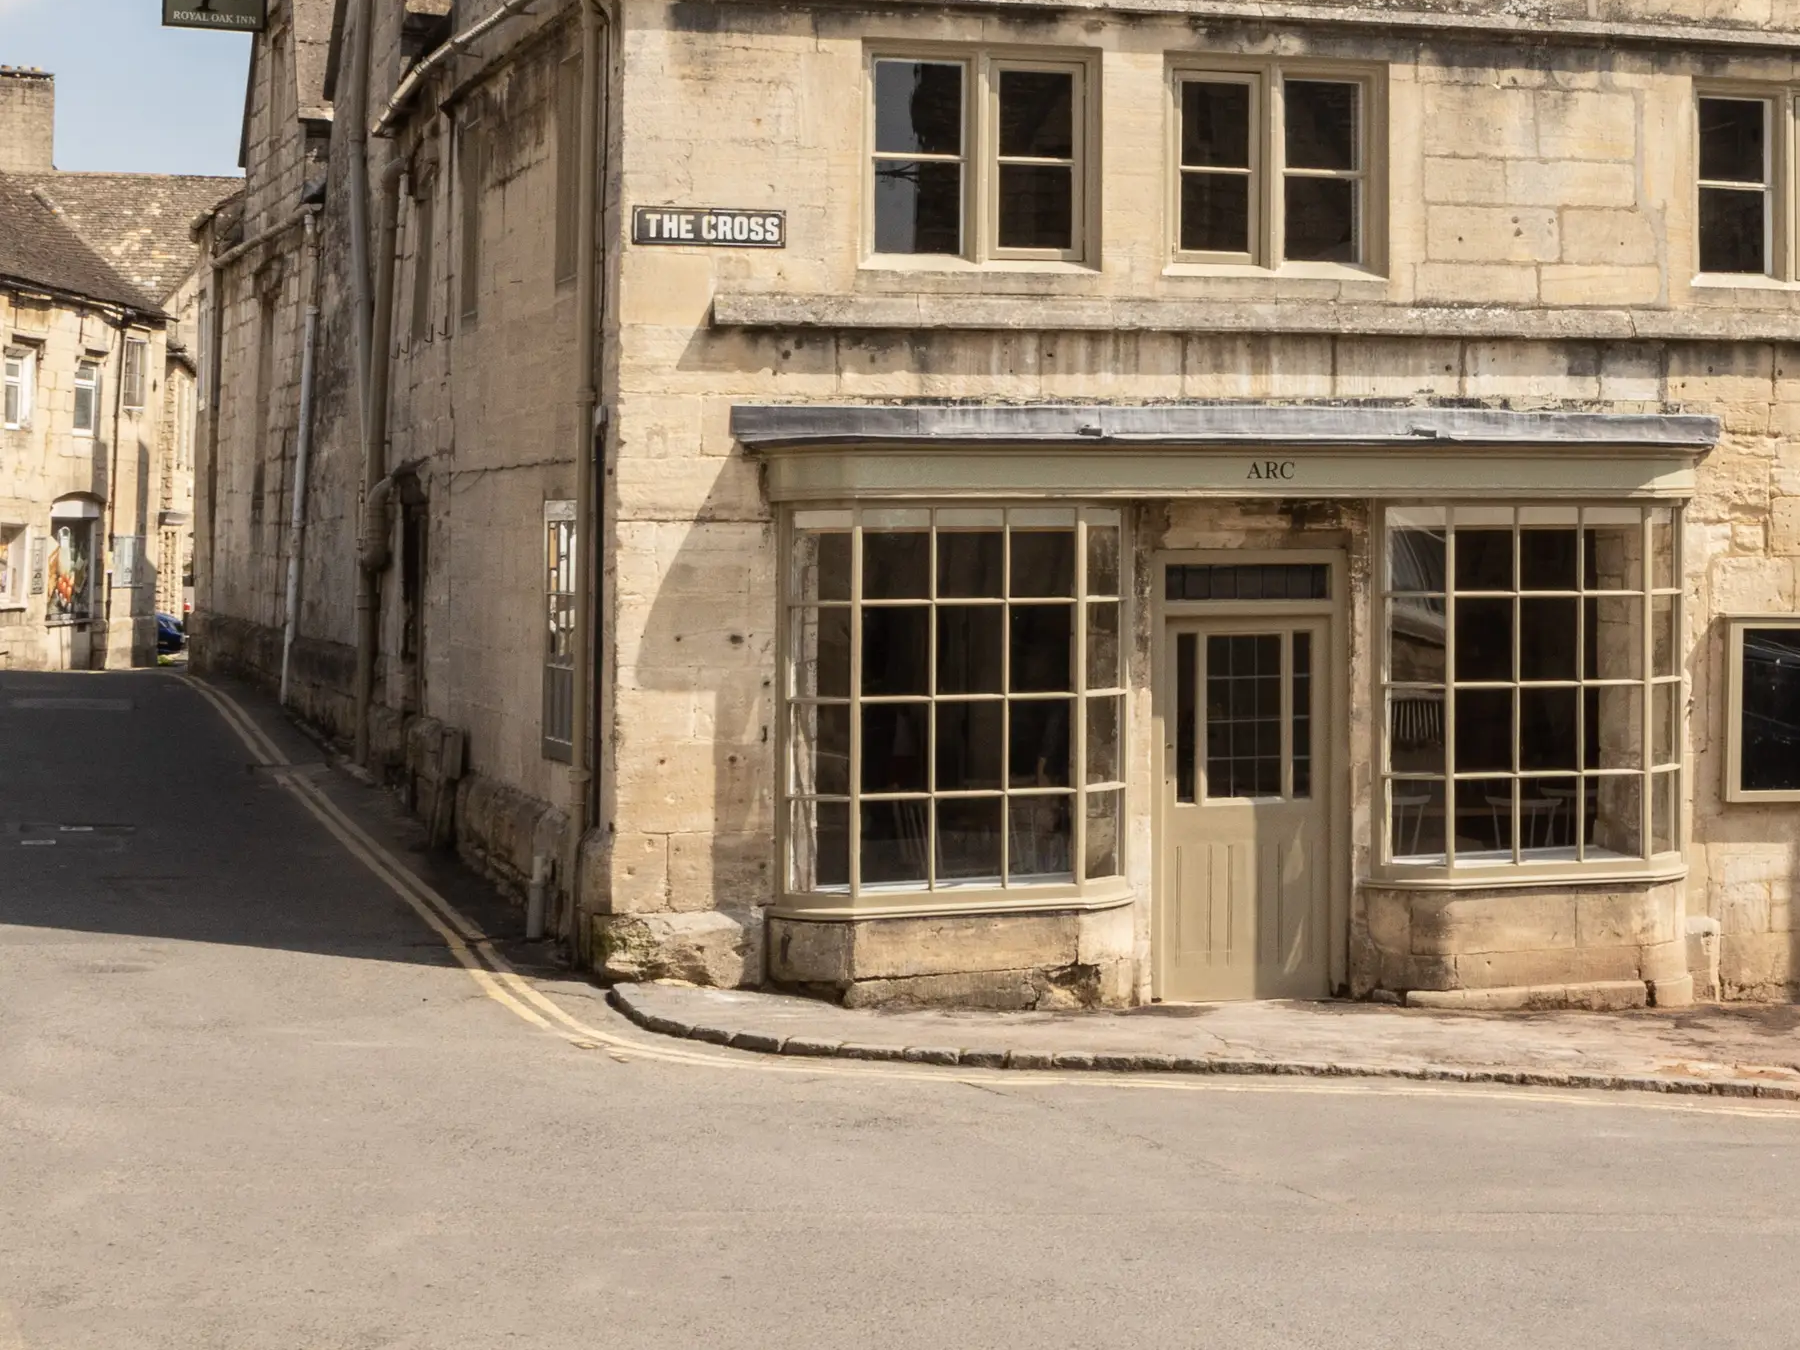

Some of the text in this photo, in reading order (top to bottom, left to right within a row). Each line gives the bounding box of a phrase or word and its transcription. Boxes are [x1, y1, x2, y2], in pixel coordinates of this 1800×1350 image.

[173, 10, 256, 25] ROYAL OAK INN
[645, 213, 781, 242] THE CROSS
[1246, 461, 1295, 480] ARC
